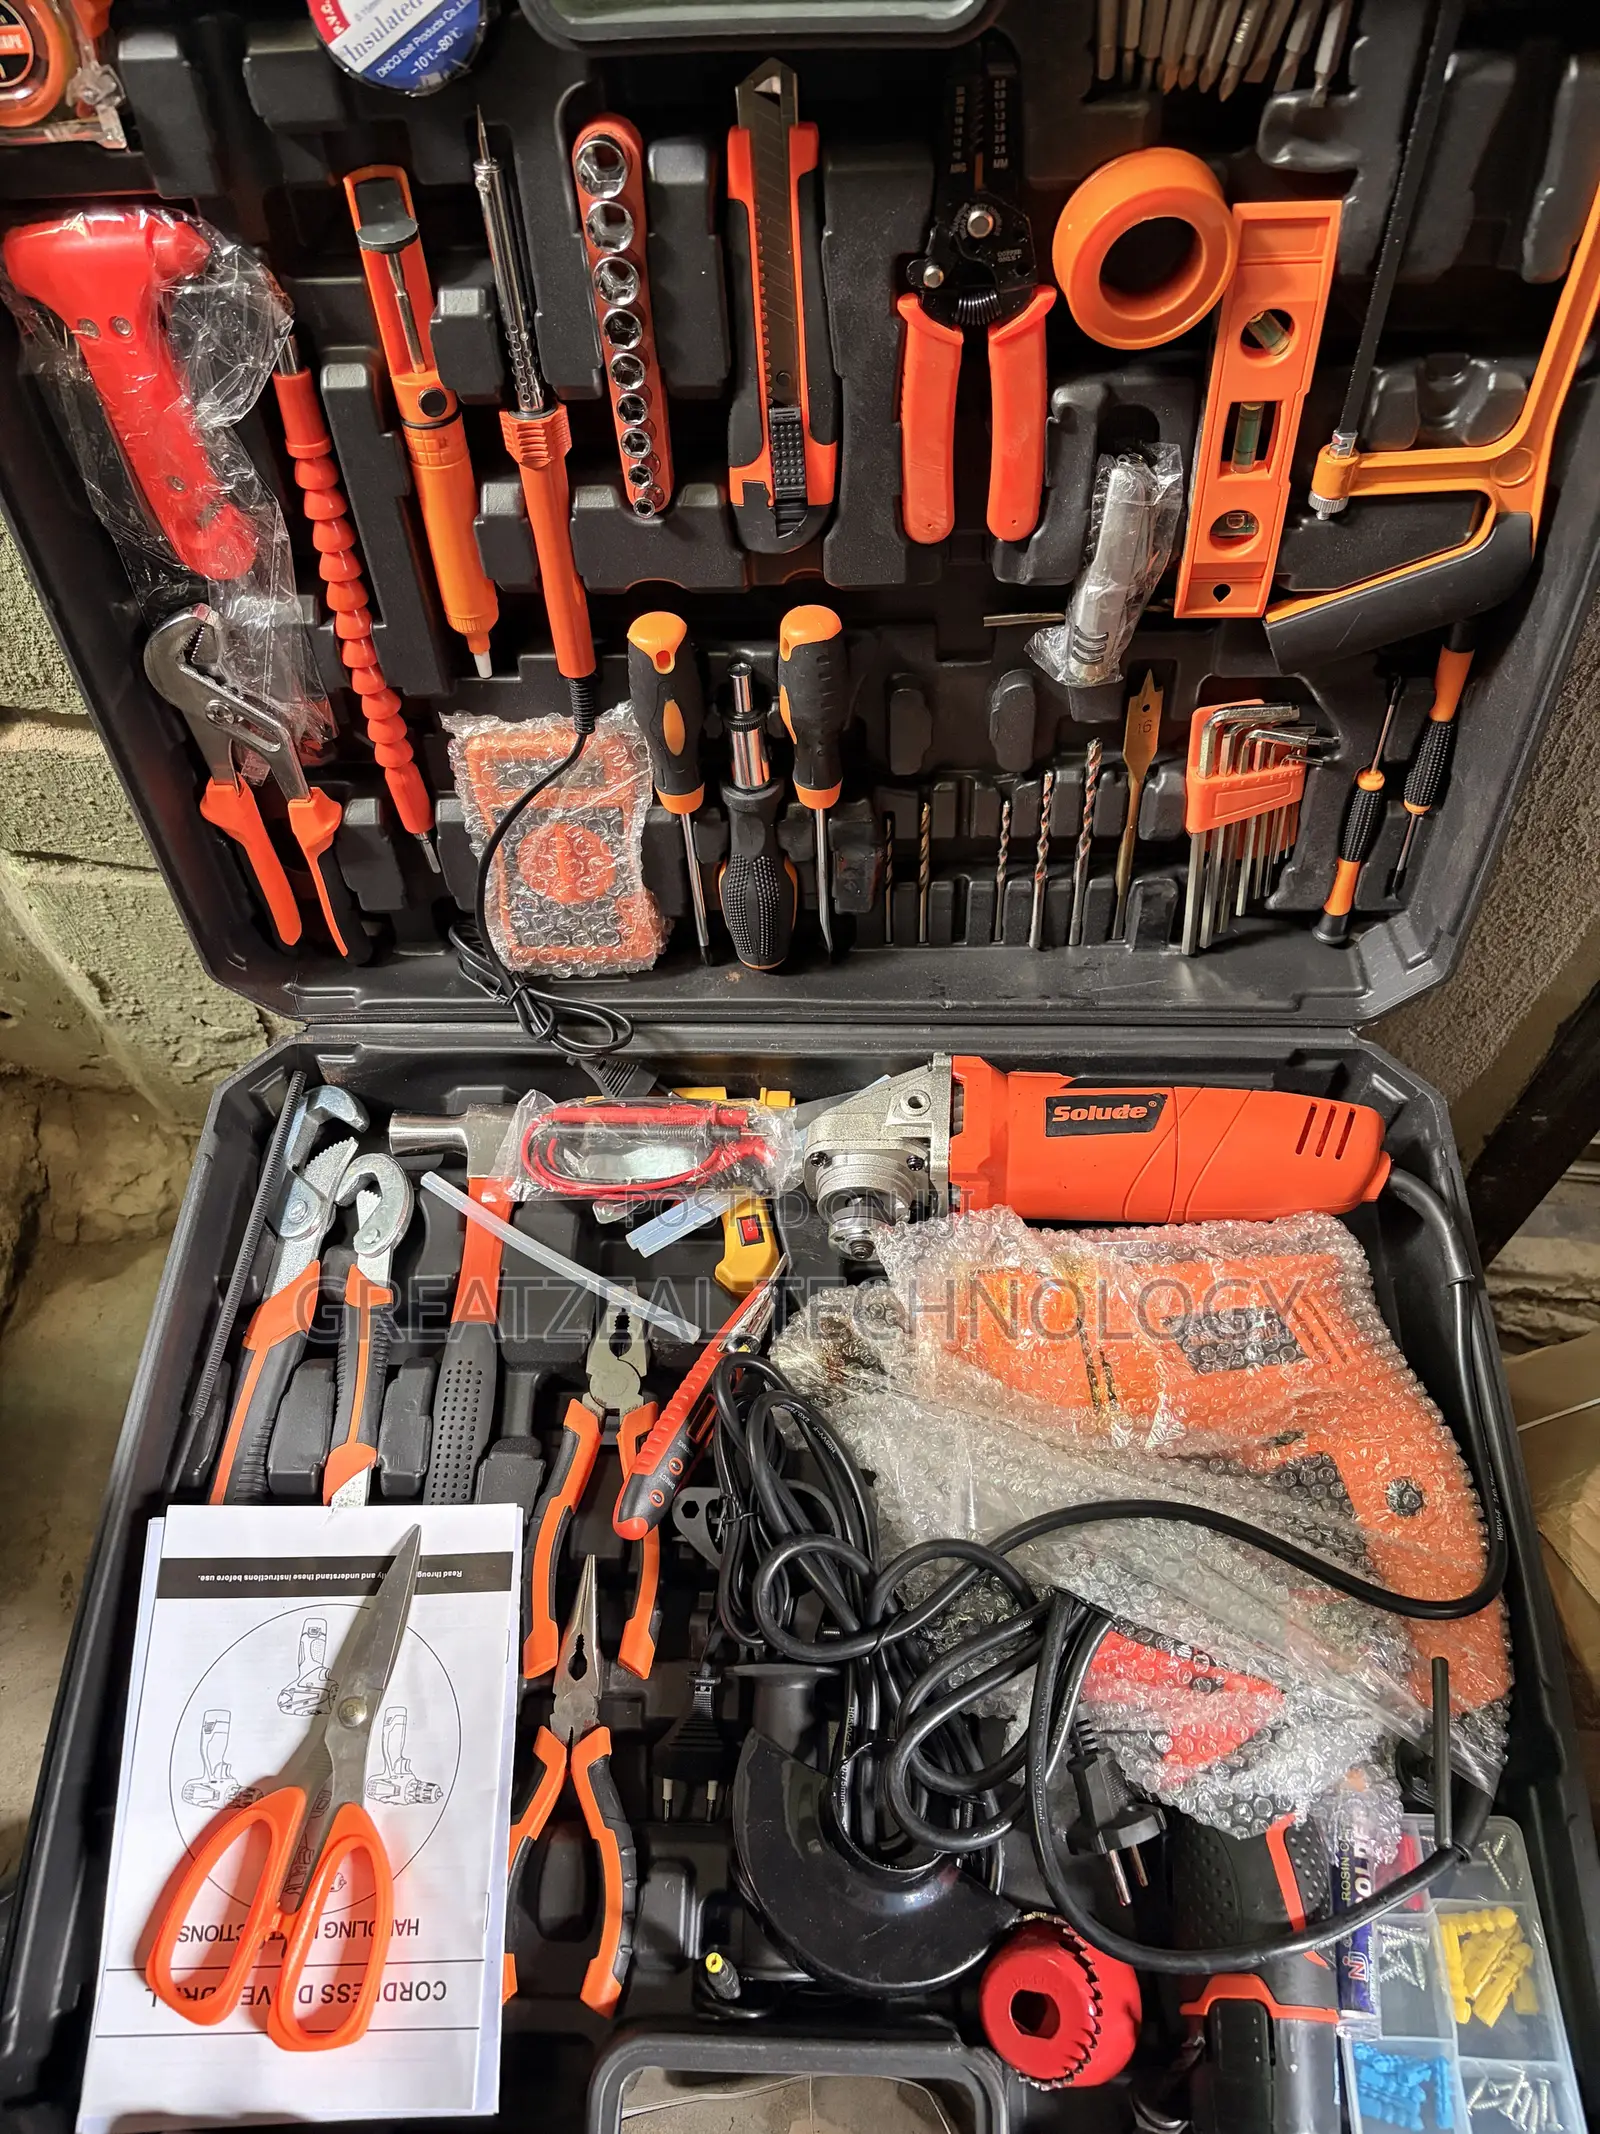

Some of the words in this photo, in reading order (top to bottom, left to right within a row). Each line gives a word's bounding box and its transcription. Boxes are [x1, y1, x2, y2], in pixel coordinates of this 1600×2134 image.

[412, 17, 446, 47] Products
[216, 1574, 242, 1582] before
[293, 1573, 315, 1581] these
[1340, 1856, 1351, 1902] ROSIN
